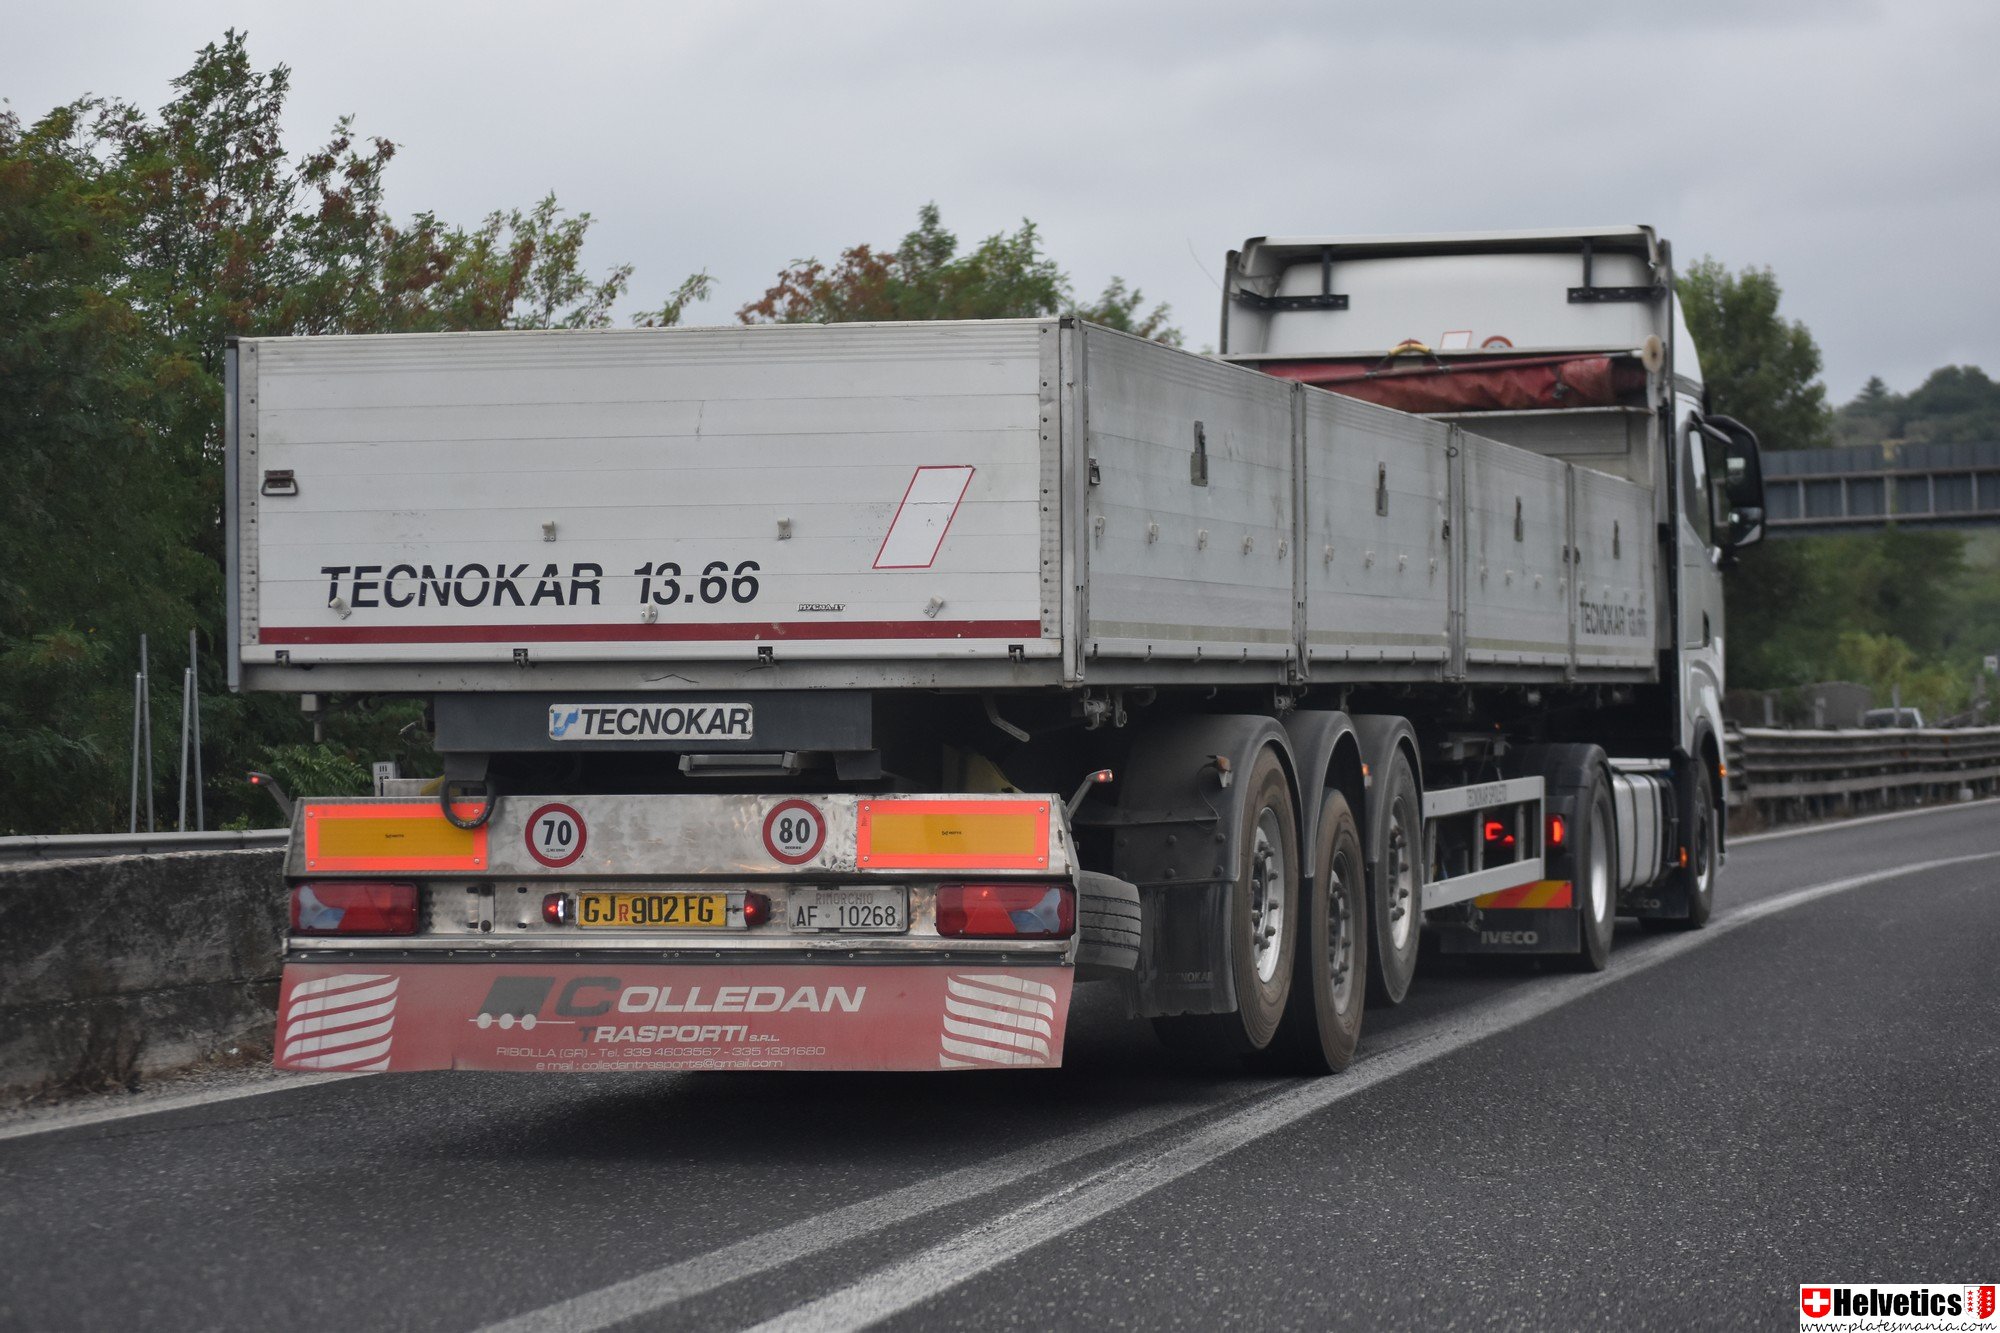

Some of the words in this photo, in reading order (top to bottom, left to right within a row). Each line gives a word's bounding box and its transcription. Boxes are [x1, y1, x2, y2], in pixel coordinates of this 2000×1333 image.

[321, 563, 603, 608] TECNOKAR
[634, 561, 760, 605] 13.66
[581, 708, 749, 735] TECNOKAR
[542, 820, 572, 846] 70
[779, 817, 811, 844] 80
[815, 892, 874, 906] RIMORCHIO
[796, 906, 818, 926] AF
[839, 905, 896, 927] 10268
[1481, 930, 1539, 946] IVECO
[556, 976, 867, 1017] COLLEDAN
[579, 1025, 748, 1043] TRASPORTI
[496, 1046, 557, 1058] RIBOLLA
[623, 1047, 652, 1057] 339
[731, 1046, 761, 1057] 335
